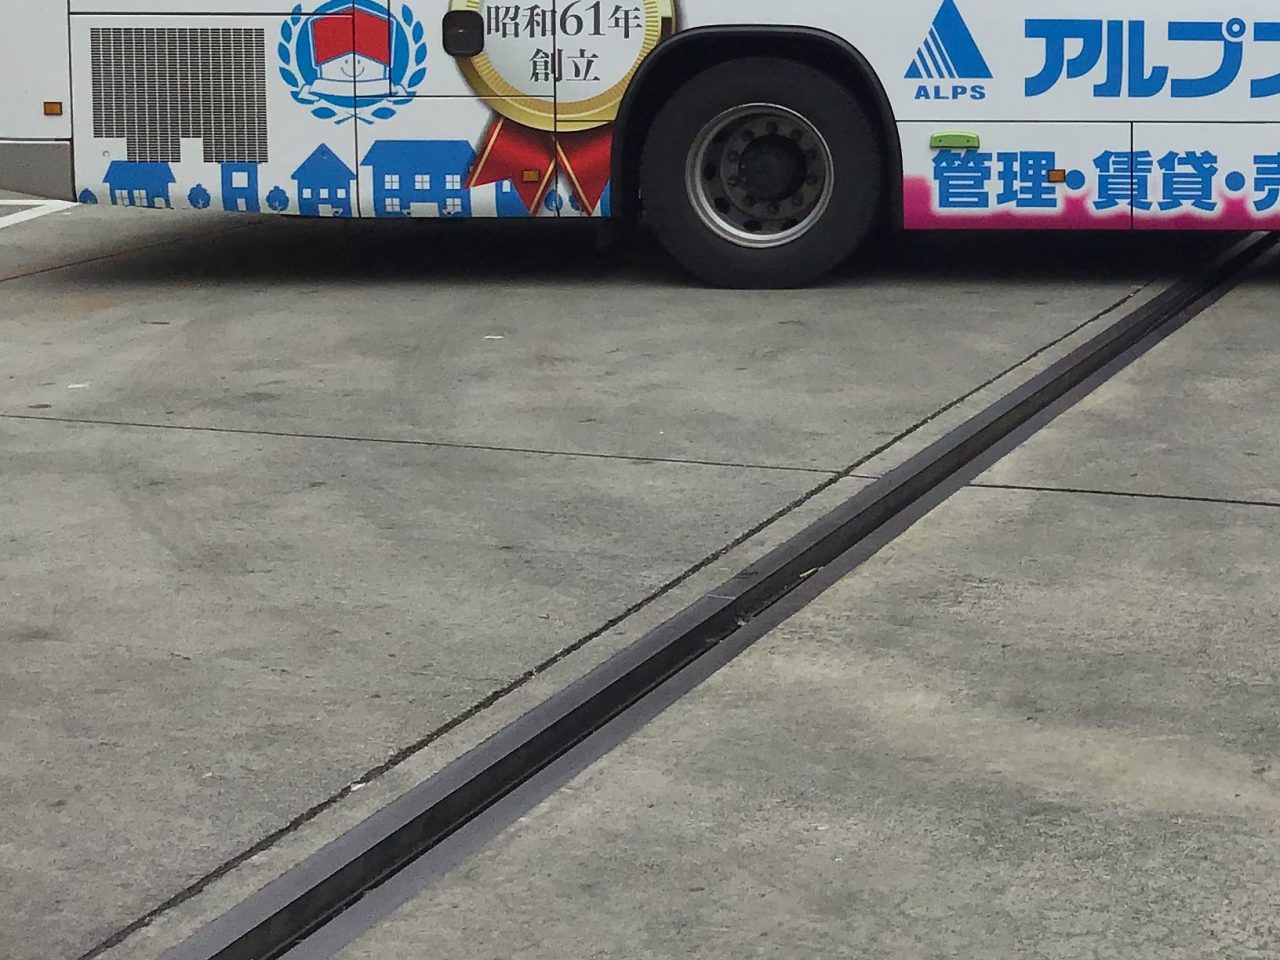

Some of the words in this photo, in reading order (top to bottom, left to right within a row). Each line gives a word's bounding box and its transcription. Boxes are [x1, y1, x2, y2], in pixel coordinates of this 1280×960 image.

[486, 0, 643, 39] 昭和61年
[529, 48, 601, 83] 創立
[914, 84, 986, 100] ALPS
